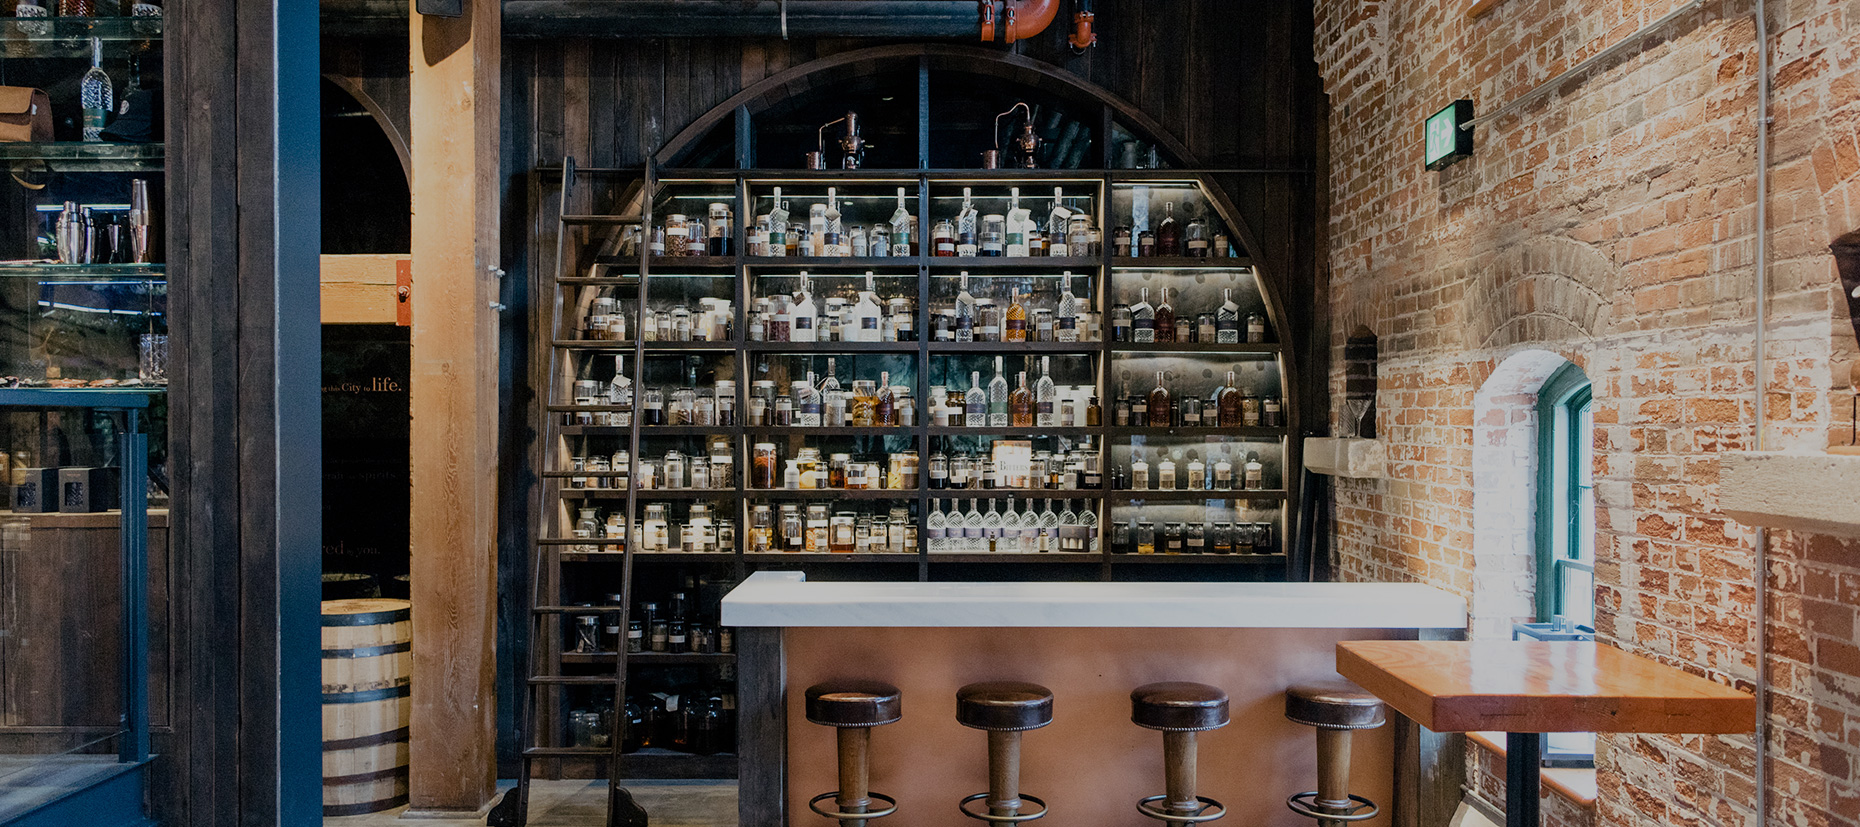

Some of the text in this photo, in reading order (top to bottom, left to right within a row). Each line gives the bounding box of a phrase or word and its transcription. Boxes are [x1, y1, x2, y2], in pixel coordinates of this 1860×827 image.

[341, 382, 361, 395] City
[371, 376, 402, 392] life.
[355, 546, 381, 558] you.
